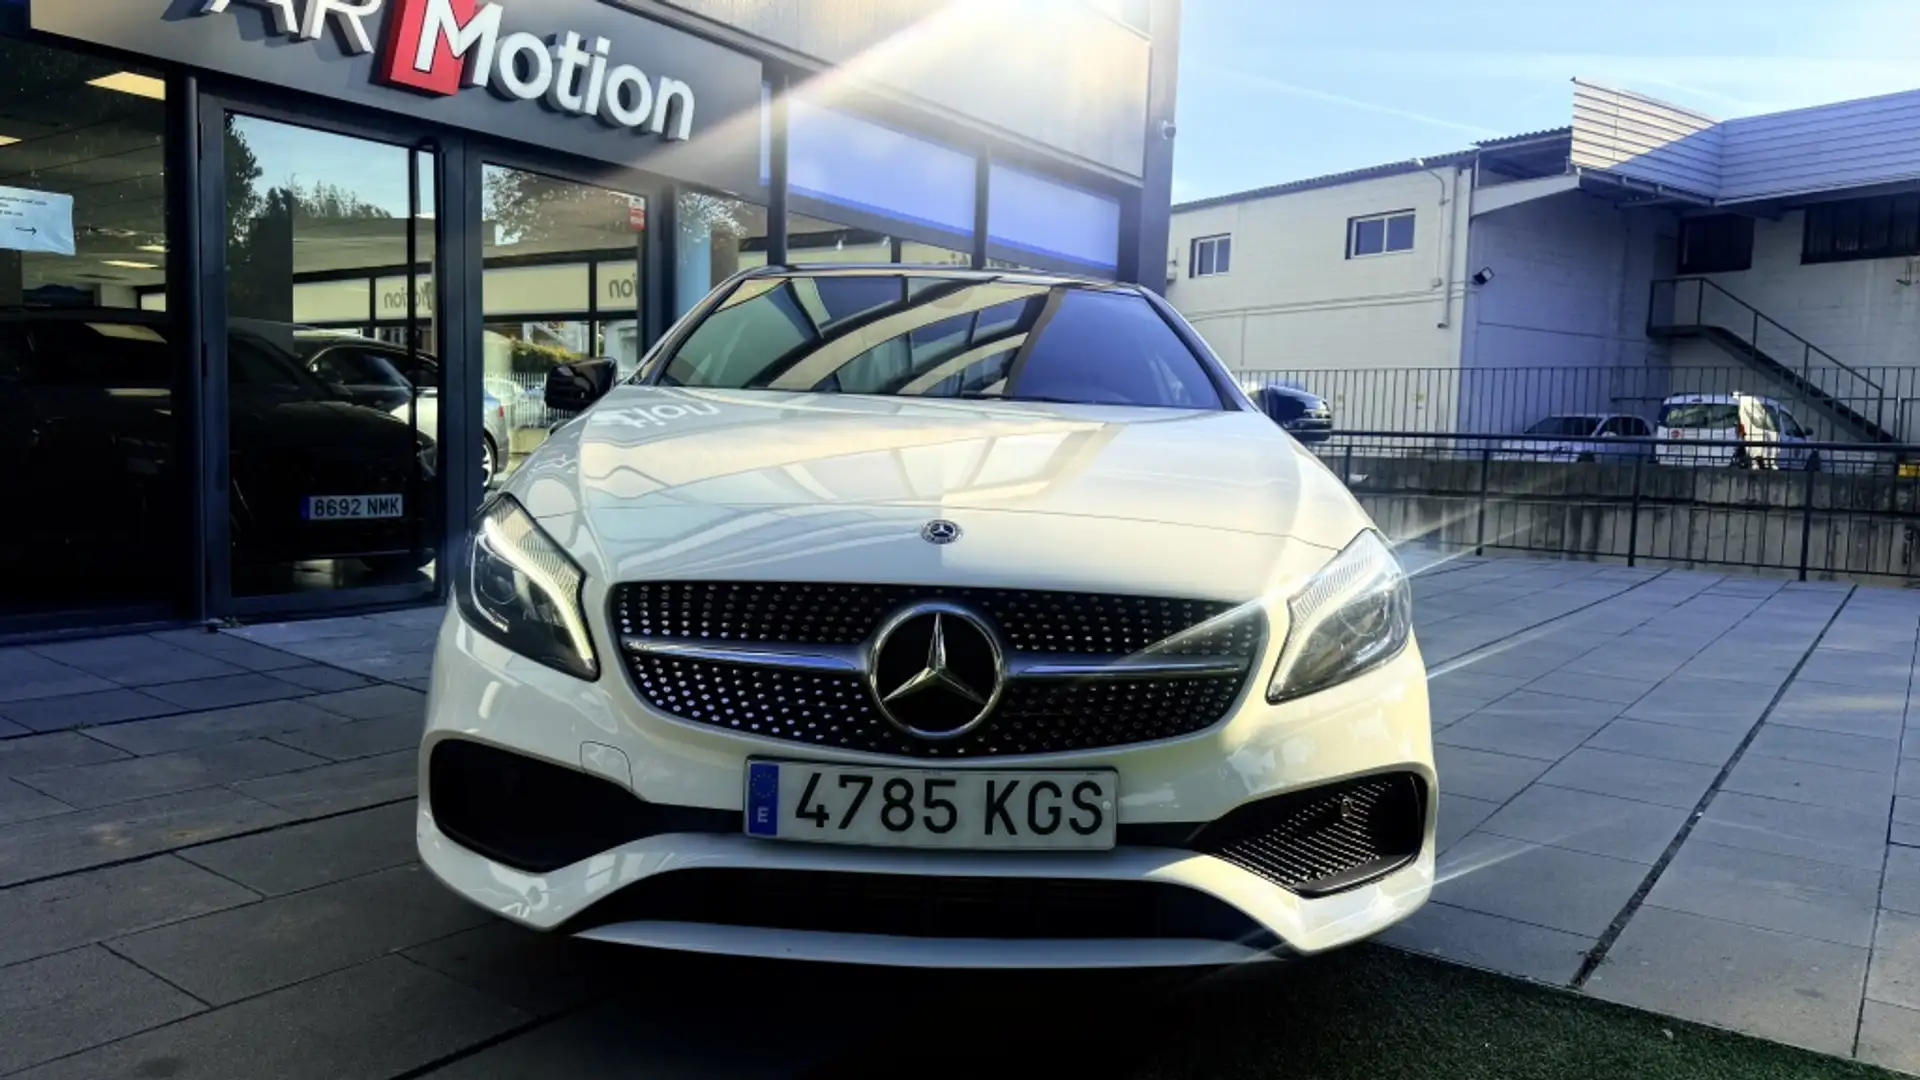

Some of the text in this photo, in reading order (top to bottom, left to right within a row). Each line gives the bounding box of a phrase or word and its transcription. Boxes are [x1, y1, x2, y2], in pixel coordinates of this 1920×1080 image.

[414, 0, 695, 140] Motion
[314, 497, 400, 517] 8692 NMK
[757, 806, 769, 823] E
[795, 772, 1104, 836] 4785 KGS
